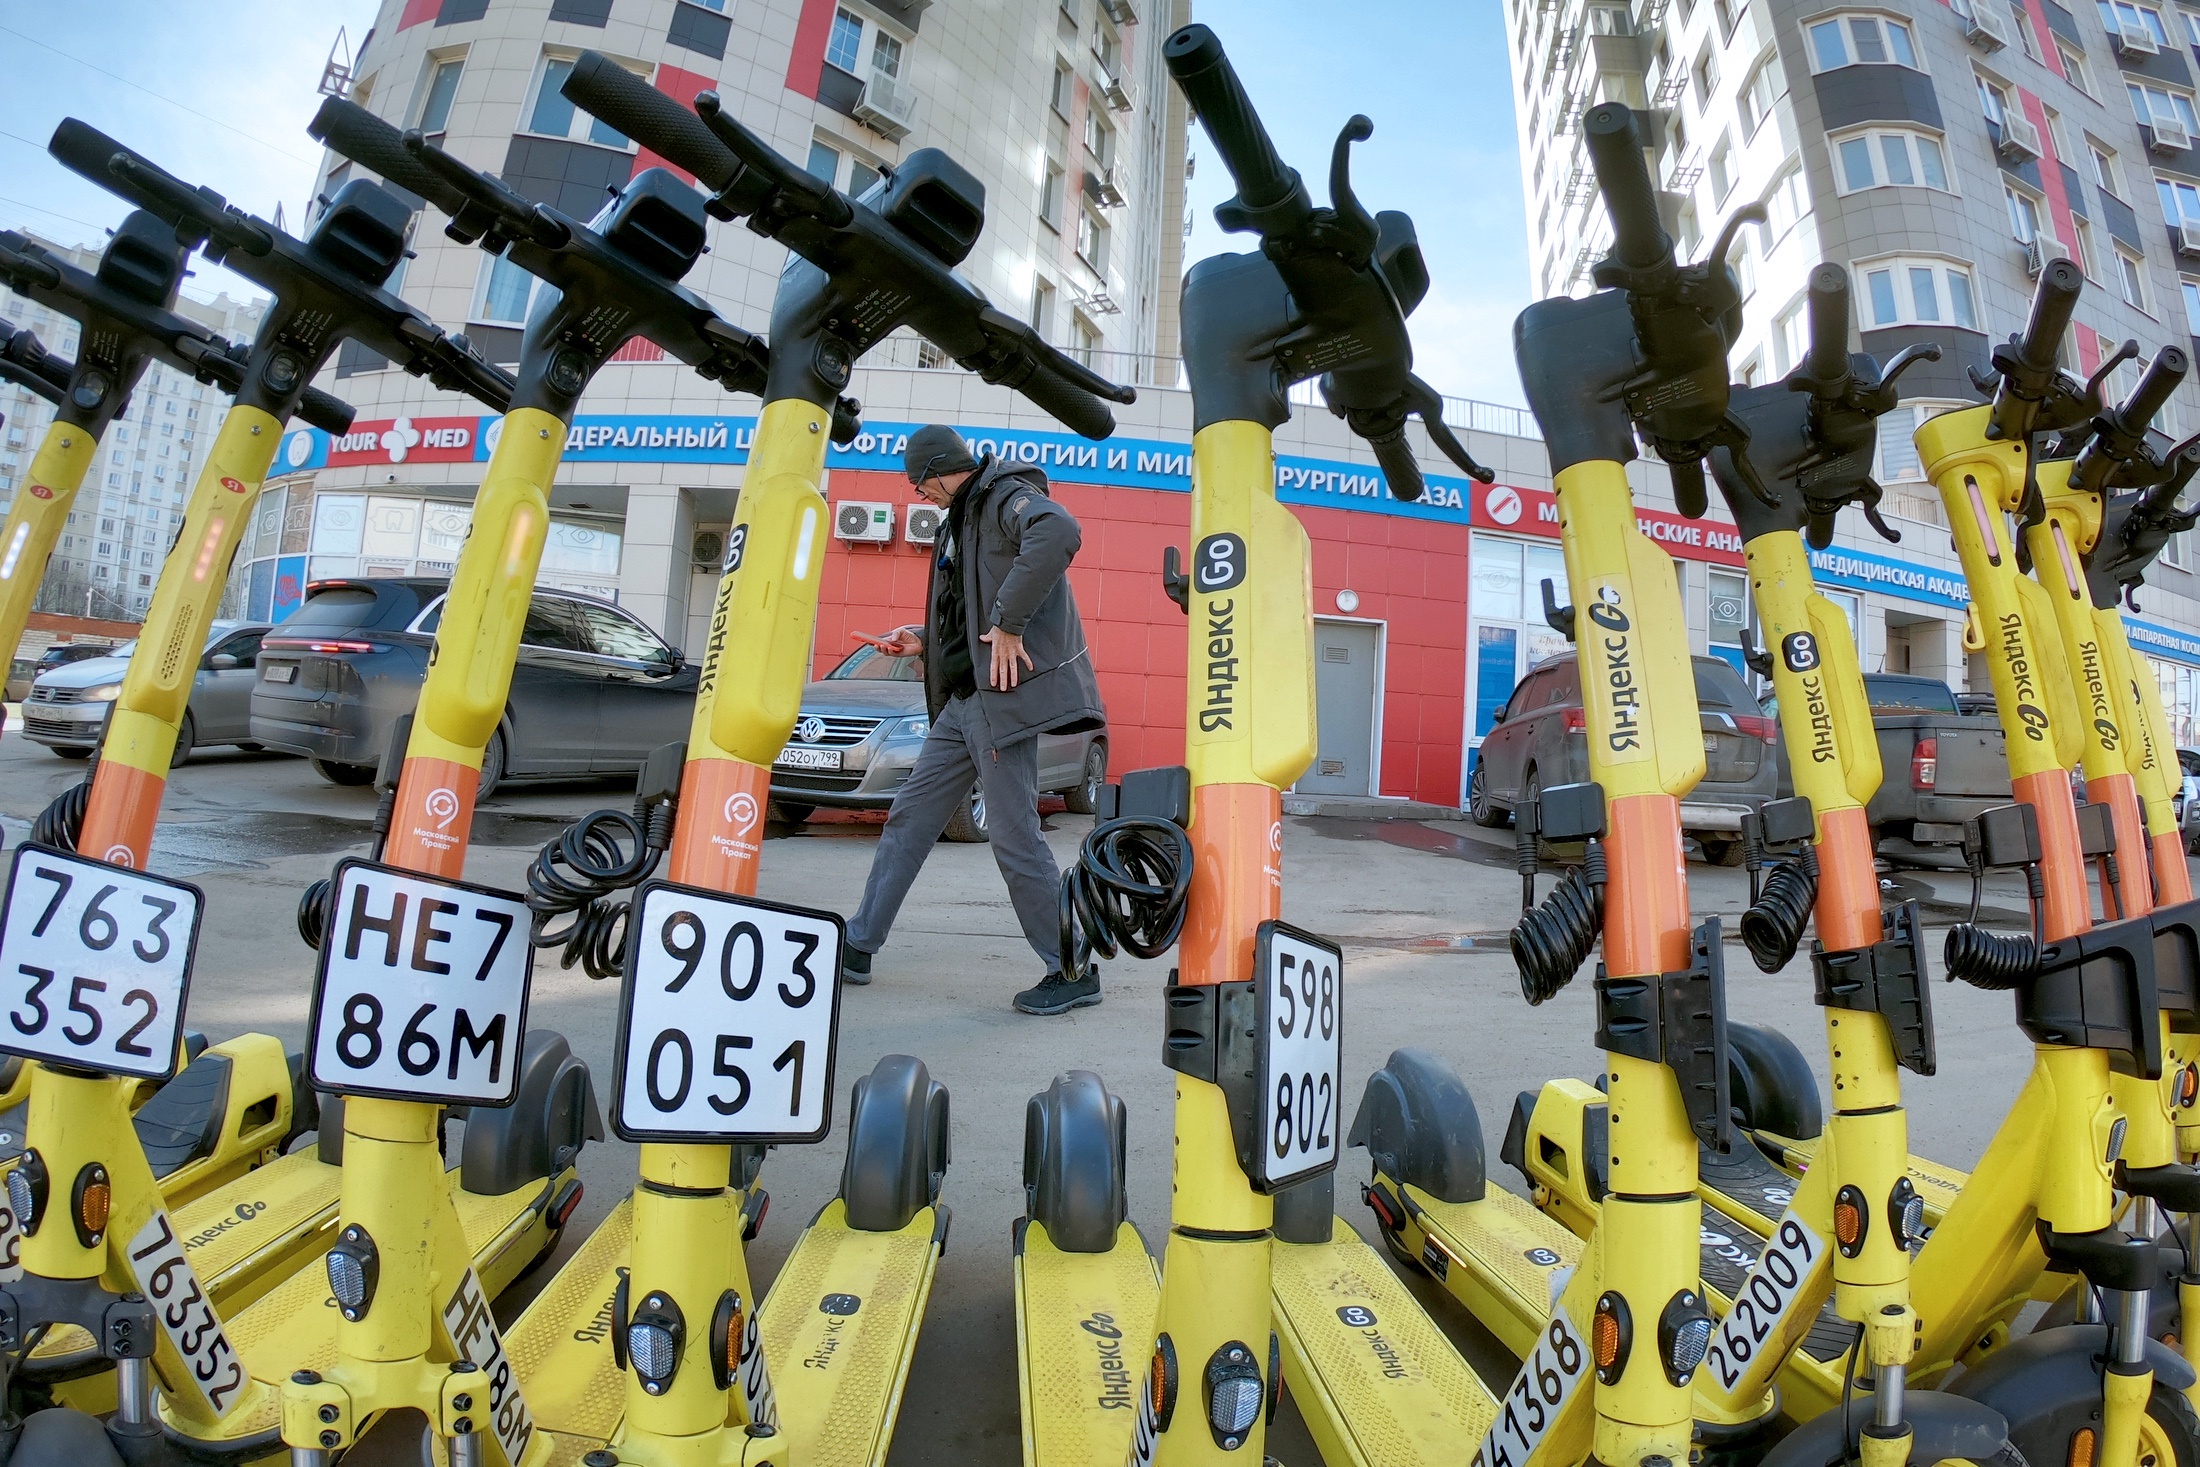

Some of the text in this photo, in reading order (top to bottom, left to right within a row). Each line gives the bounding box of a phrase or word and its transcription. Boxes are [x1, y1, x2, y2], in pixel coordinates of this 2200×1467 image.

[331, 427, 470, 454] YOUR MED
[564, 421, 729, 451] ДЕРАЛЬНЫЙ
[1107, 448, 1128, 470] И
[723, 528, 745, 571] Go
[1811, 549, 1926, 592] МЕДИЦИНСКАЯ
[1199, 538, 1239, 733] Яндекс Go
[1998, 612, 2050, 742] Яндекс Go
[2133, 626, 2180, 651] АППАРАТНАЯ
[1602, 634, 1640, 752] Яндекс
[1791, 634, 1836, 763] Яндекс Go
[2078, 640, 2117, 752] Яндекс Go
[421, 837, 451, 850] Прокат
[721, 846, 752, 860] Прокат
[31, 865, 177, 964] 763
[661, 909, 819, 1010] 903
[9, 962, 160, 1058] 352
[1278, 953, 1334, 1041] 598
[646, 1026, 807, 1118] 051
[1274, 1071, 1332, 1160] 802
[182, 1200, 267, 1252] ндекс Go
[131, 1214, 248, 1413] 763352
[1346, 1306, 1409, 1380] Яндекс Go
[1708, 1218, 1815, 1382] 262009
[1079, 1311, 1133, 1410] Яндекс Go
